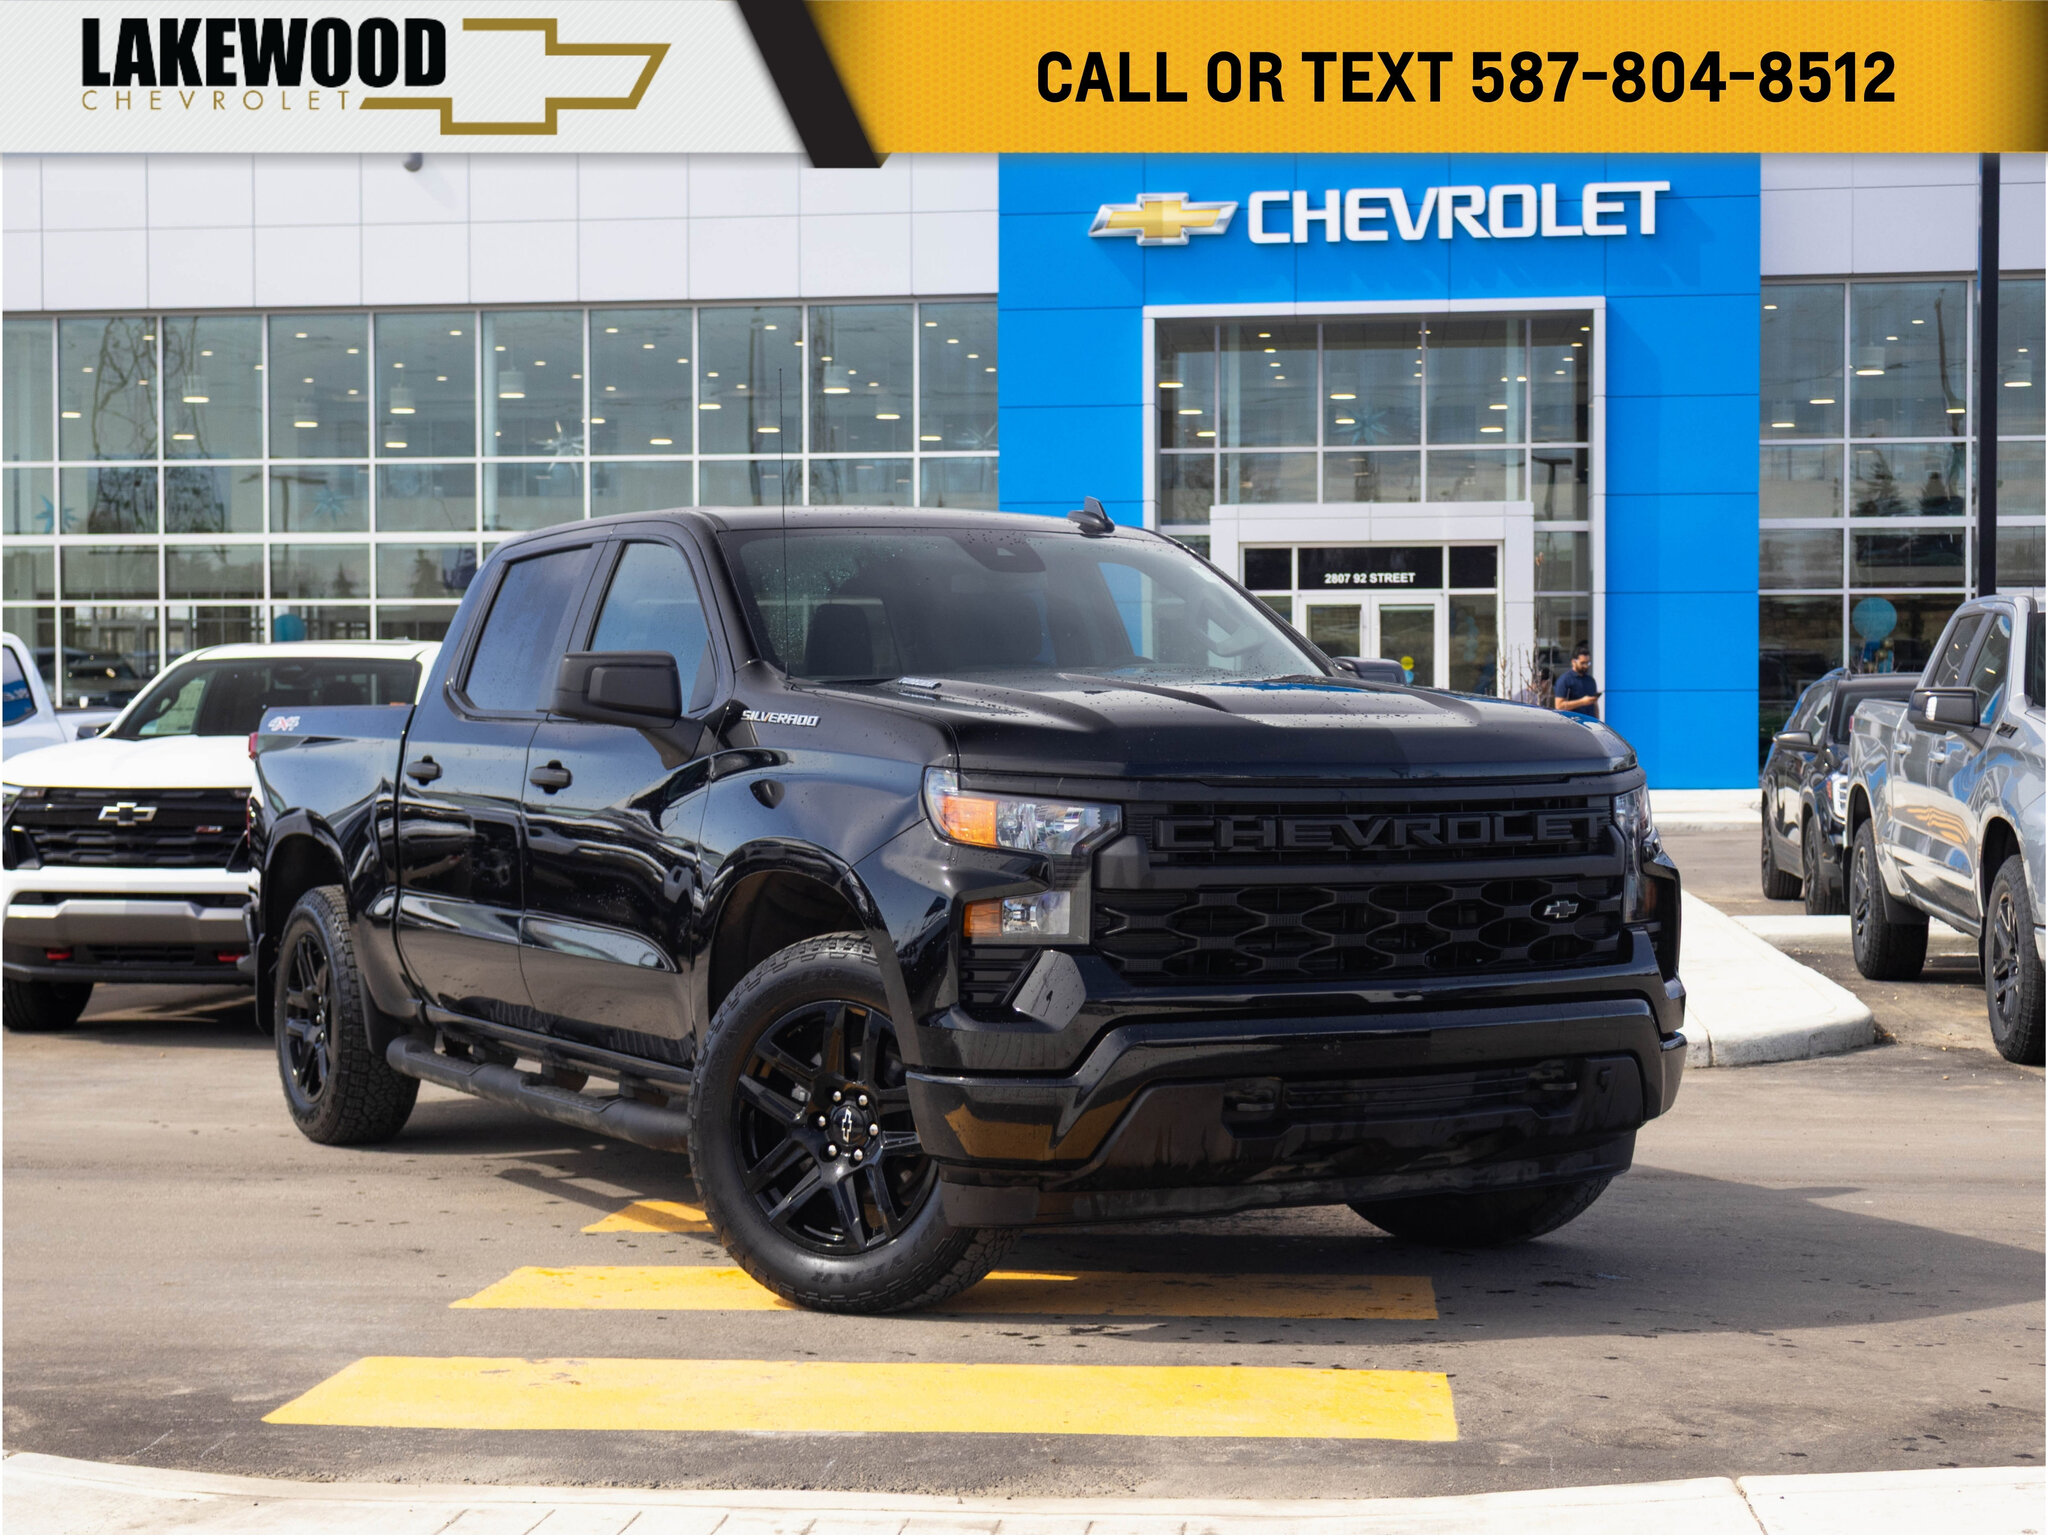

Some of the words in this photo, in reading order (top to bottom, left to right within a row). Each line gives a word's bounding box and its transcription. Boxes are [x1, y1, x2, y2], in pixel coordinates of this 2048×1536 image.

[1248, 181, 1671, 244] CHEVROLET
[1324, 573, 1351, 584] 2807
[1353, 573, 1367, 584] 92
[1369, 572, 1416, 583] STREET
[741, 710, 819, 727] SILVERADO
[1157, 811, 1608, 849] CHEVROLET
